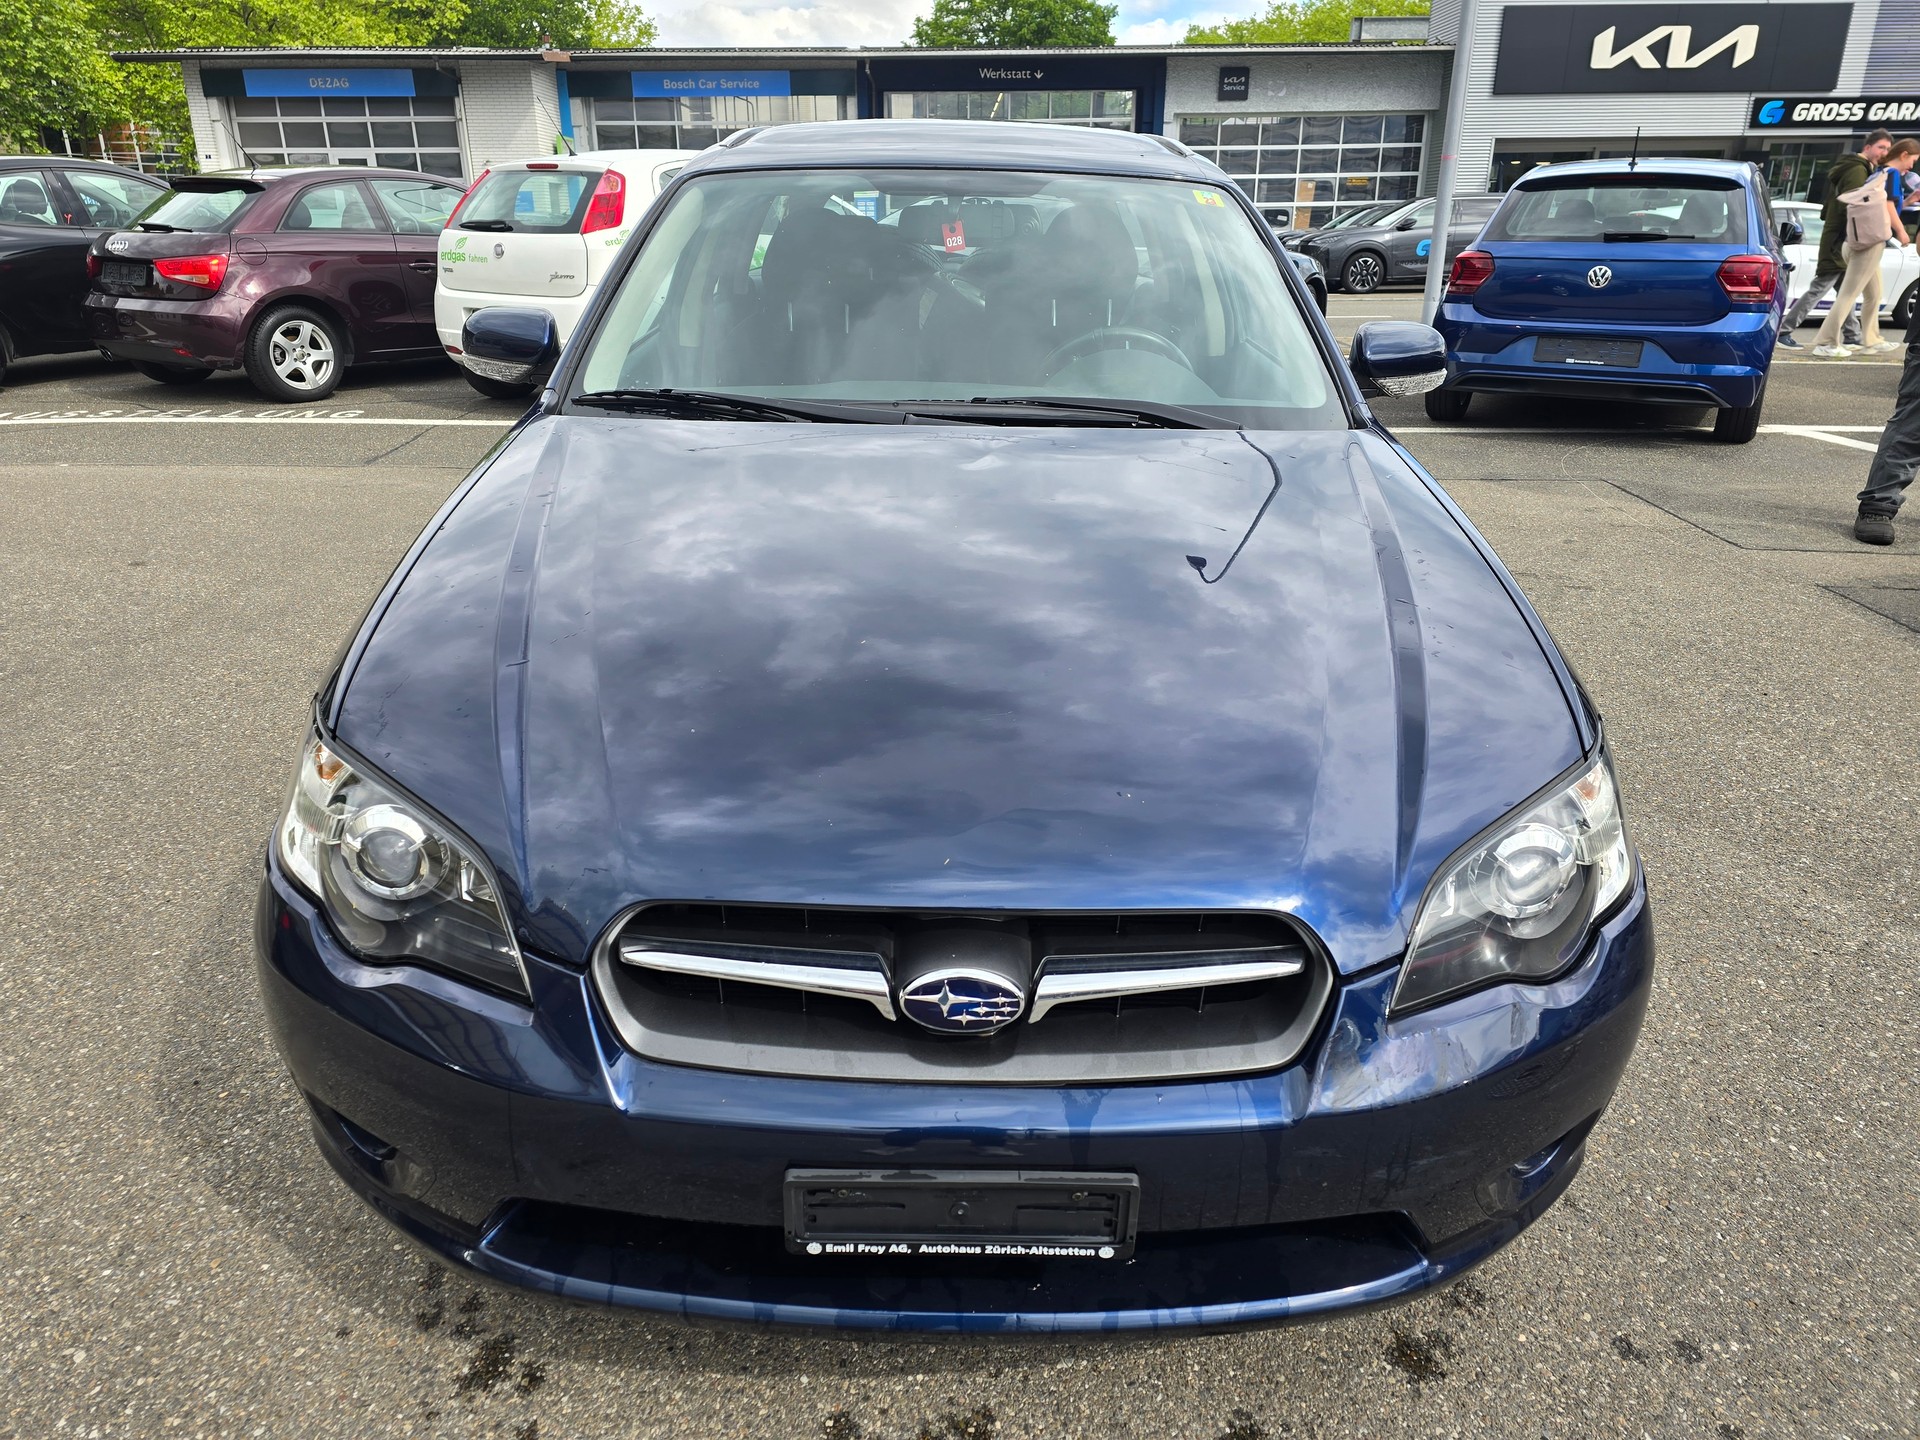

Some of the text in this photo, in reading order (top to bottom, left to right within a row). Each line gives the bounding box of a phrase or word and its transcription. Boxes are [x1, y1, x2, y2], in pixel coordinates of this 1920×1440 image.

[1590, 24, 1760, 69] KIA
[979, 68, 1031, 79] Werkstatt
[309, 77, 349, 88] DEZAG
[663, 78, 760, 89] Bosch Car Service
[1792, 102, 1867, 122] GROSS
[946, 236, 963, 247] 028
[440, 249, 488, 263] erdgas fahren
[825, 1243, 1096, 1256] Emil Frey AG, Autohaus Zürich-Altstetten
